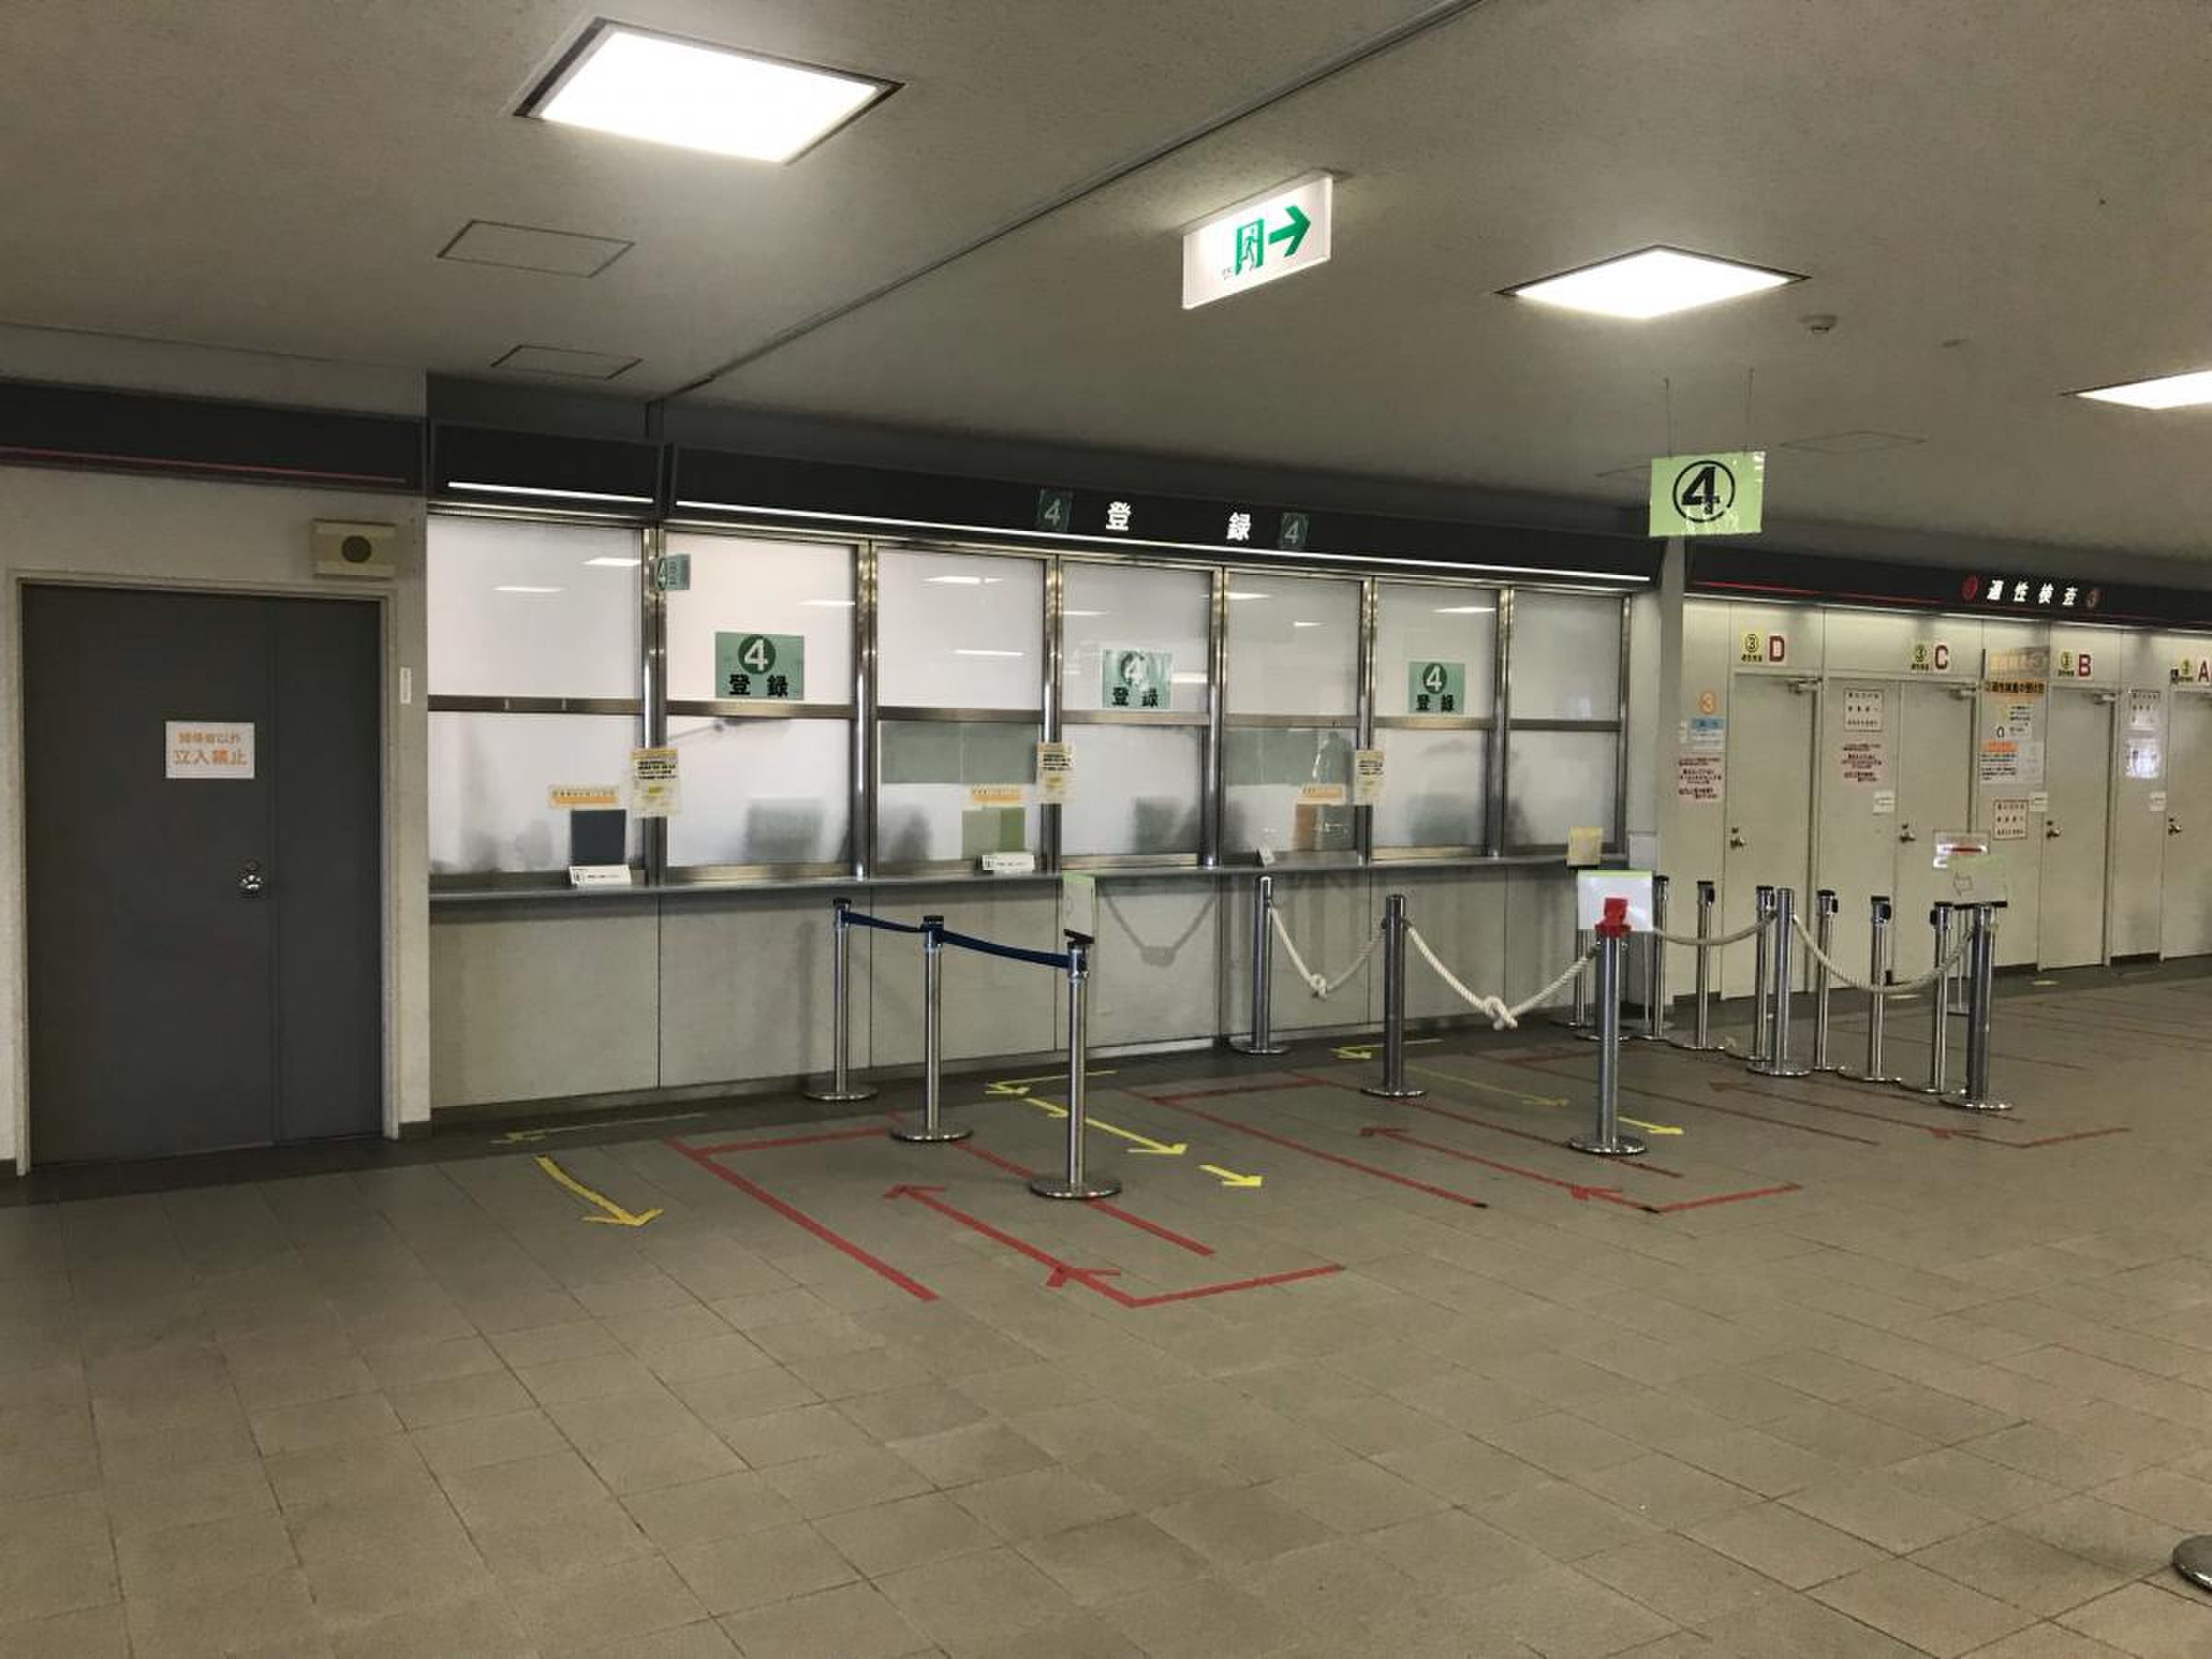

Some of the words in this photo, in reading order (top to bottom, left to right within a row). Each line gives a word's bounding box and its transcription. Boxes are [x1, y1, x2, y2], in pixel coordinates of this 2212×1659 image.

[1106, 501, 1252, 542] 登録
[1770, 636, 1784, 663] D
[1936, 645, 1948, 670] C
[2078, 653, 2091, 677] B
[2198, 660, 2209, 682] A
[728, 674, 788, 697] 登録
[1112, 687, 1159, 708] 登録
[1416, 694, 1454, 712] 登録
